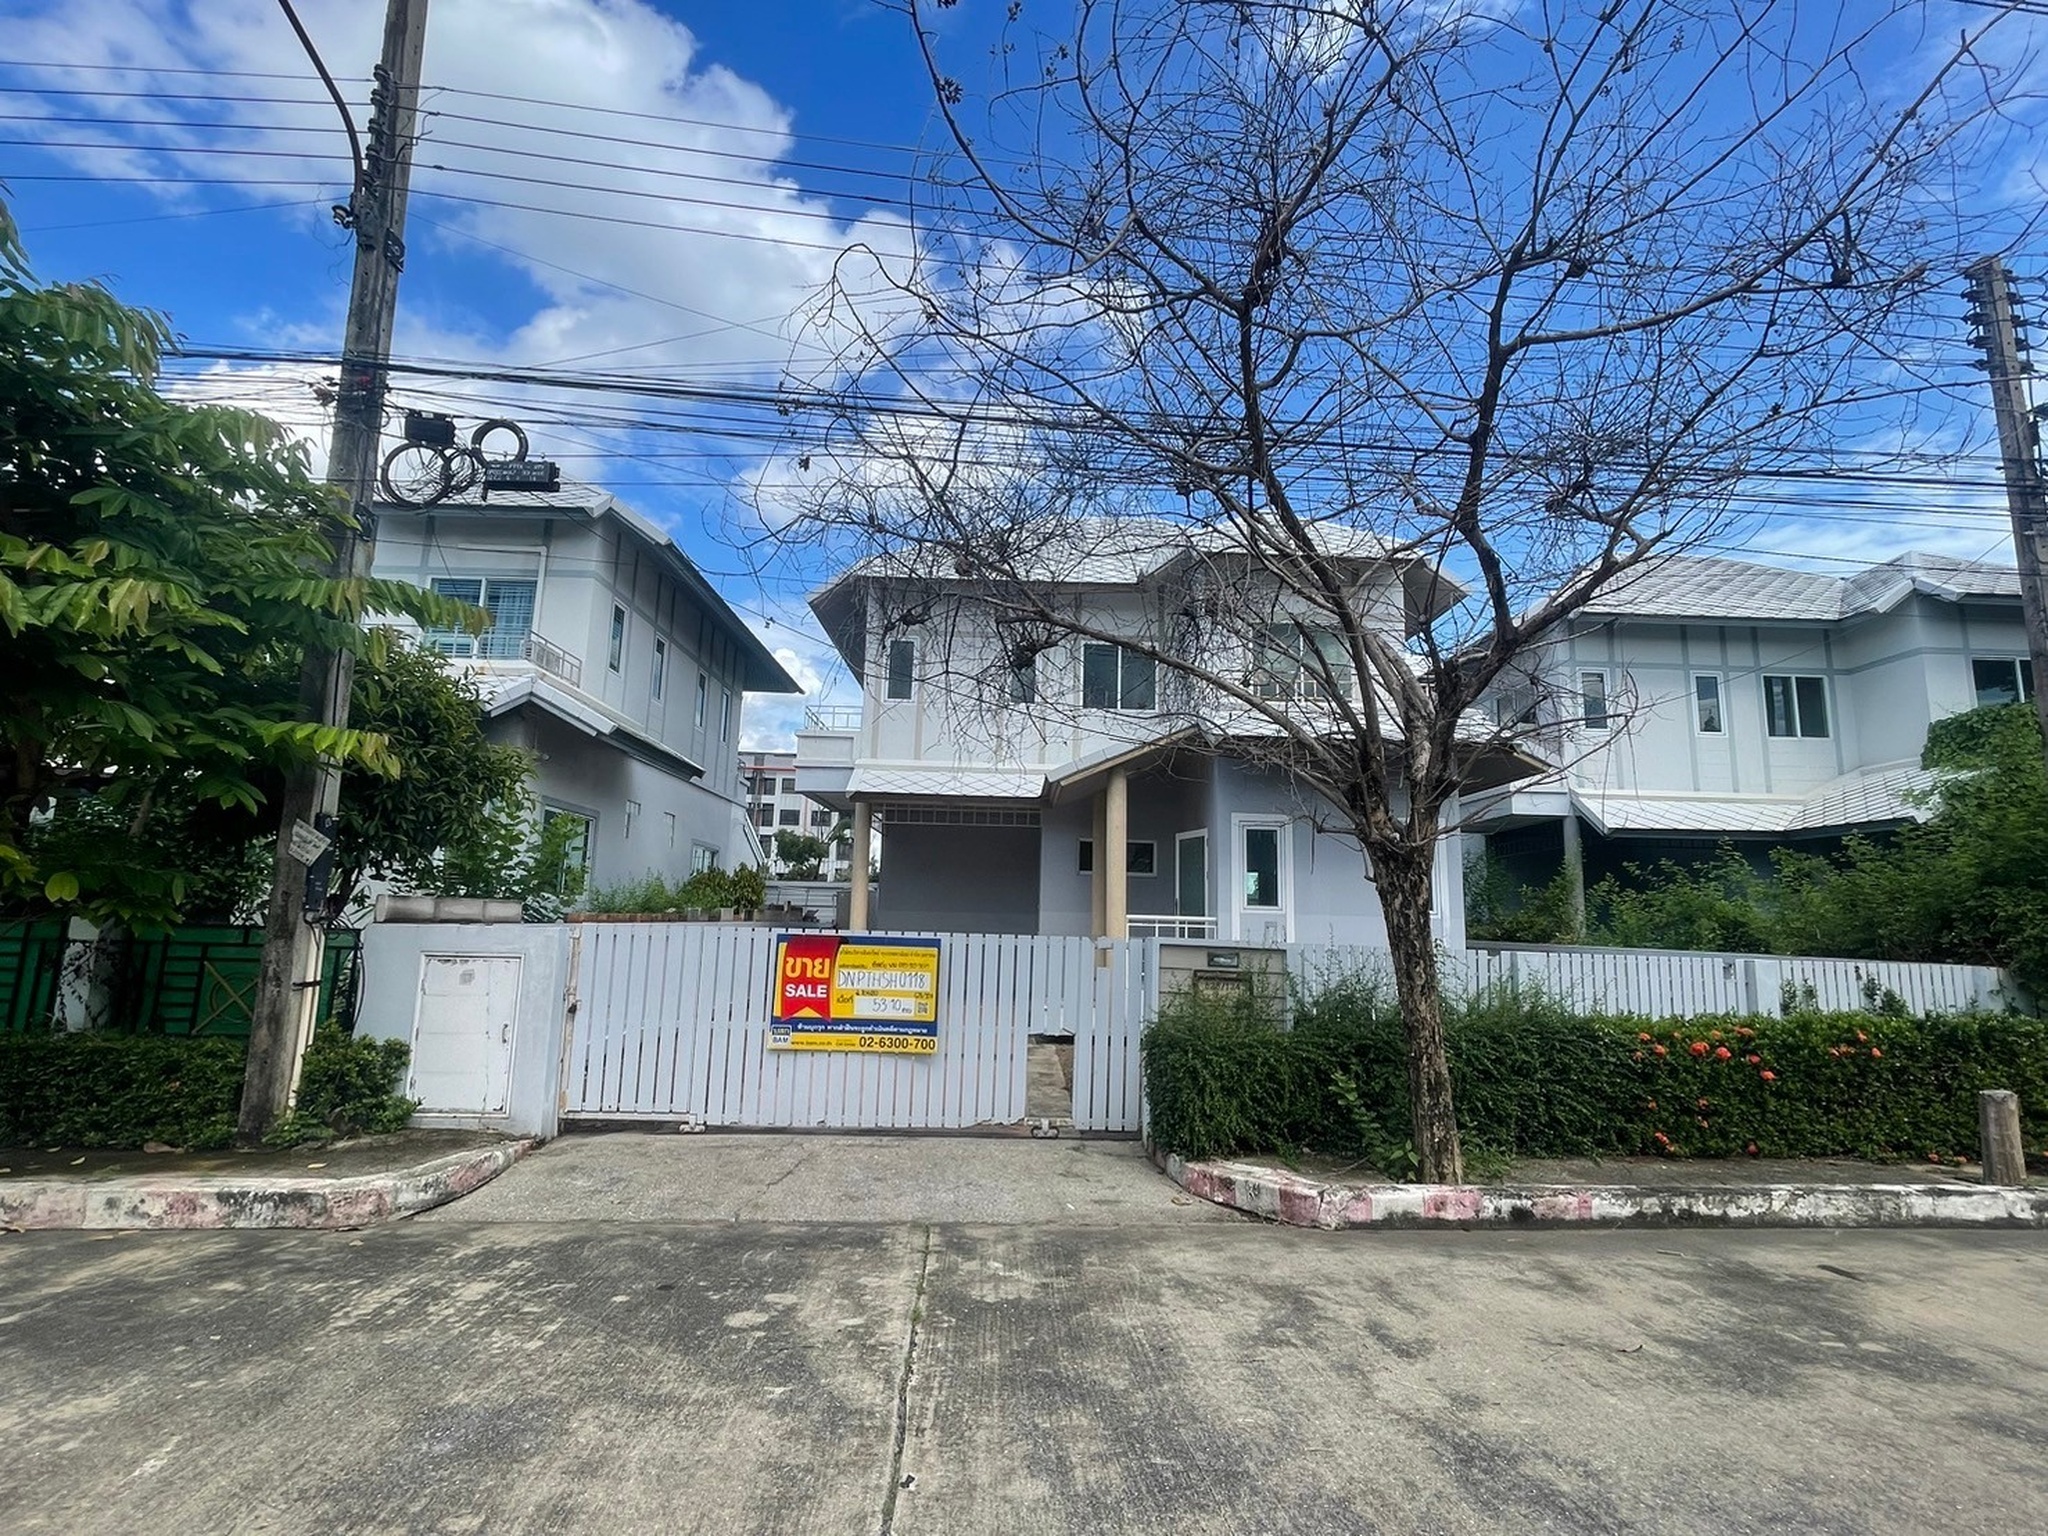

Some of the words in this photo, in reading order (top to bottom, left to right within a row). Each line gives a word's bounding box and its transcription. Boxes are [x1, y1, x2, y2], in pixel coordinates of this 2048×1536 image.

[785, 956, 830, 979] ขาย
[785, 983, 828, 998] SALE
[859, 1036, 936, 1050] 02-6300-700
